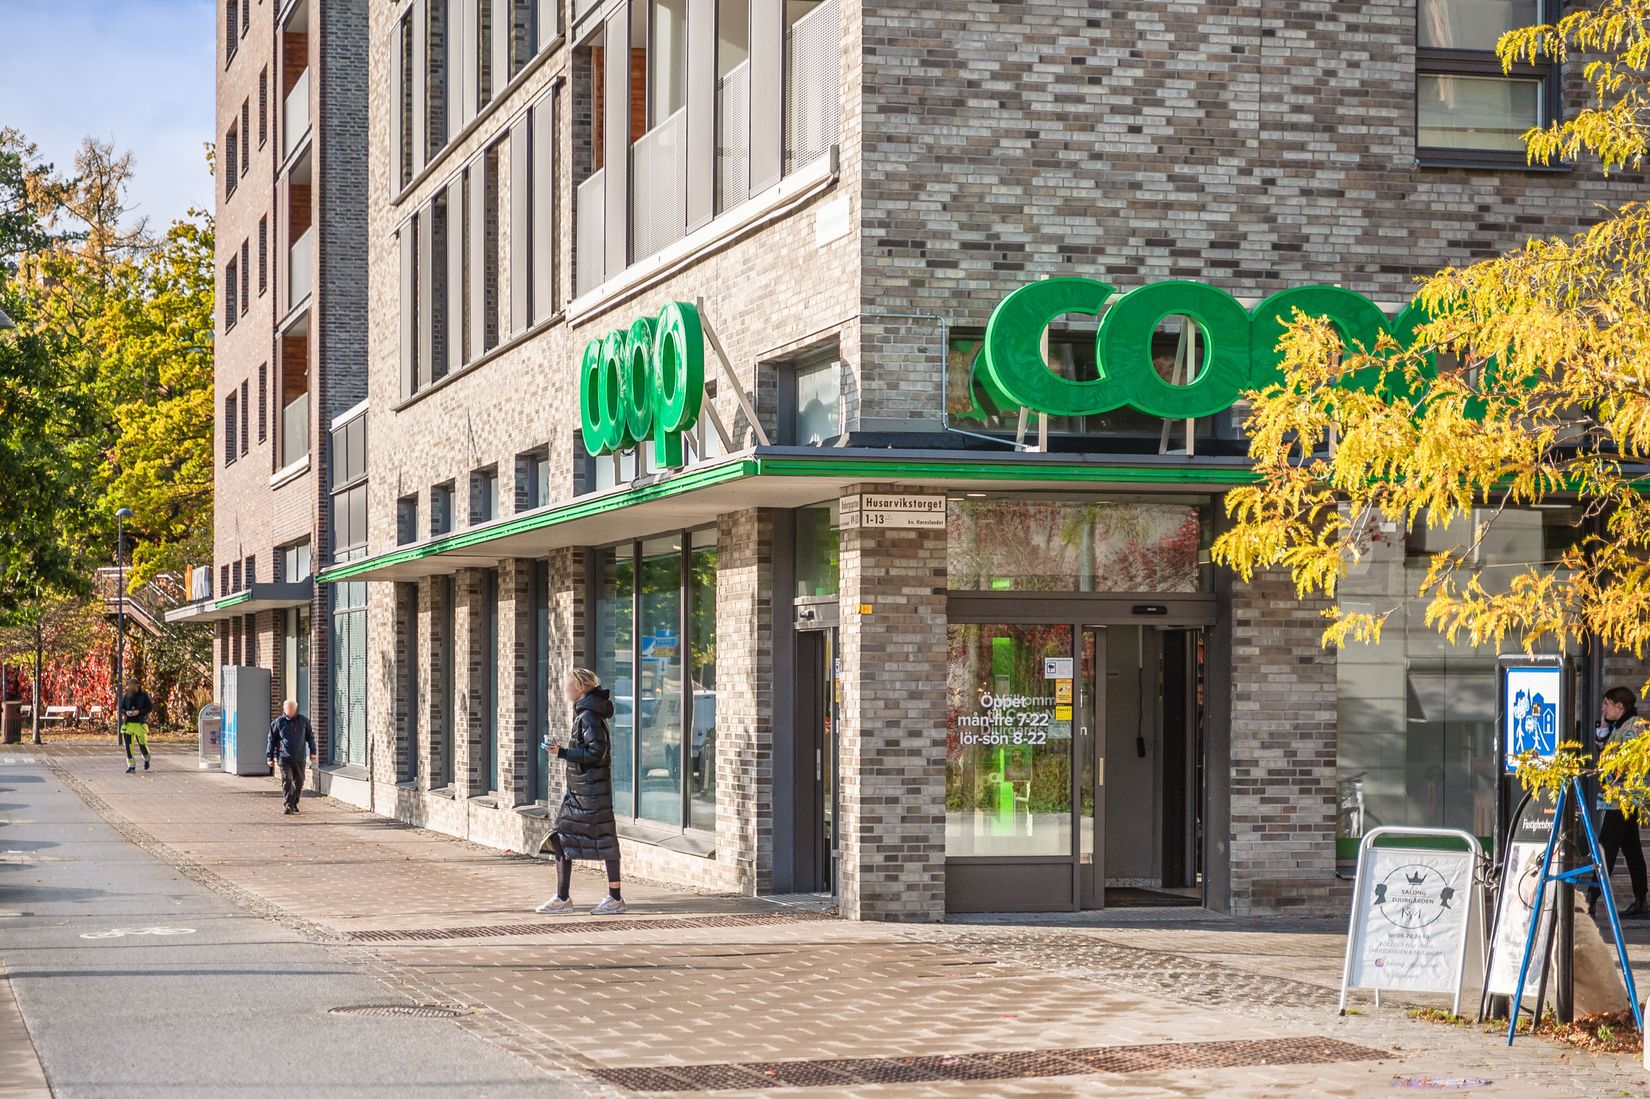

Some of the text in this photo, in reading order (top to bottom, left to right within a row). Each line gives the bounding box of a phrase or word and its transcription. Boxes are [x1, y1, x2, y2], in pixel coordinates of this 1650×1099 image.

[580, 300, 704, 469] coop
[866, 497, 942, 511] Husarvikstorget
[865, 514, 885, 525] 1-13
[980, 692, 1027, 710] Öppet
[957, 711, 1014, 726] mån-fre
[1017, 713, 1049, 726] 7-22
[959, 731, 1047, 745] lör-sön 8-22
[1391, 896, 1435, 905] DJURGÅRDEN
